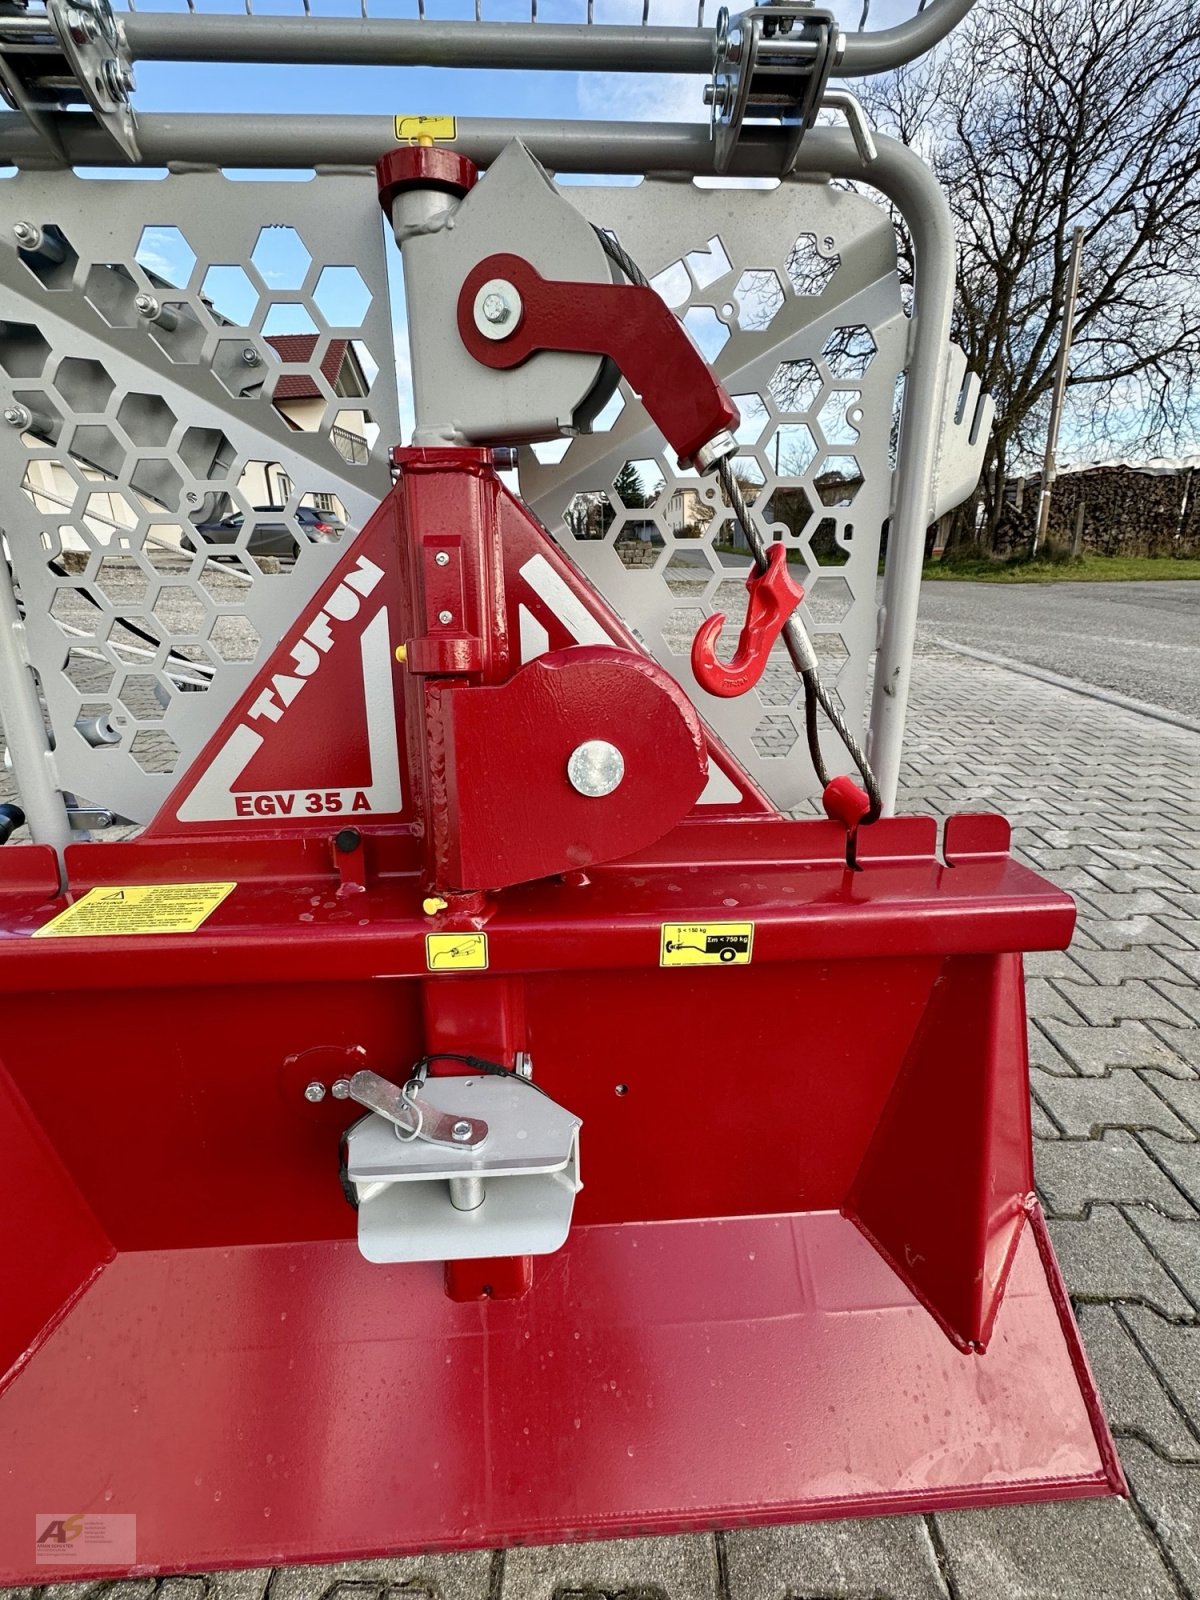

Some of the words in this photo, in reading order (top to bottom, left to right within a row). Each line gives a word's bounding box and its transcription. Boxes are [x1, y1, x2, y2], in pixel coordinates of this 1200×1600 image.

[247, 554, 386, 724] TAJFUN
[234, 794, 295, 817] EGV
[304, 792, 343, 813] 35
[351, 791, 372, 812] A
[739, 936, 748, 944] kg
